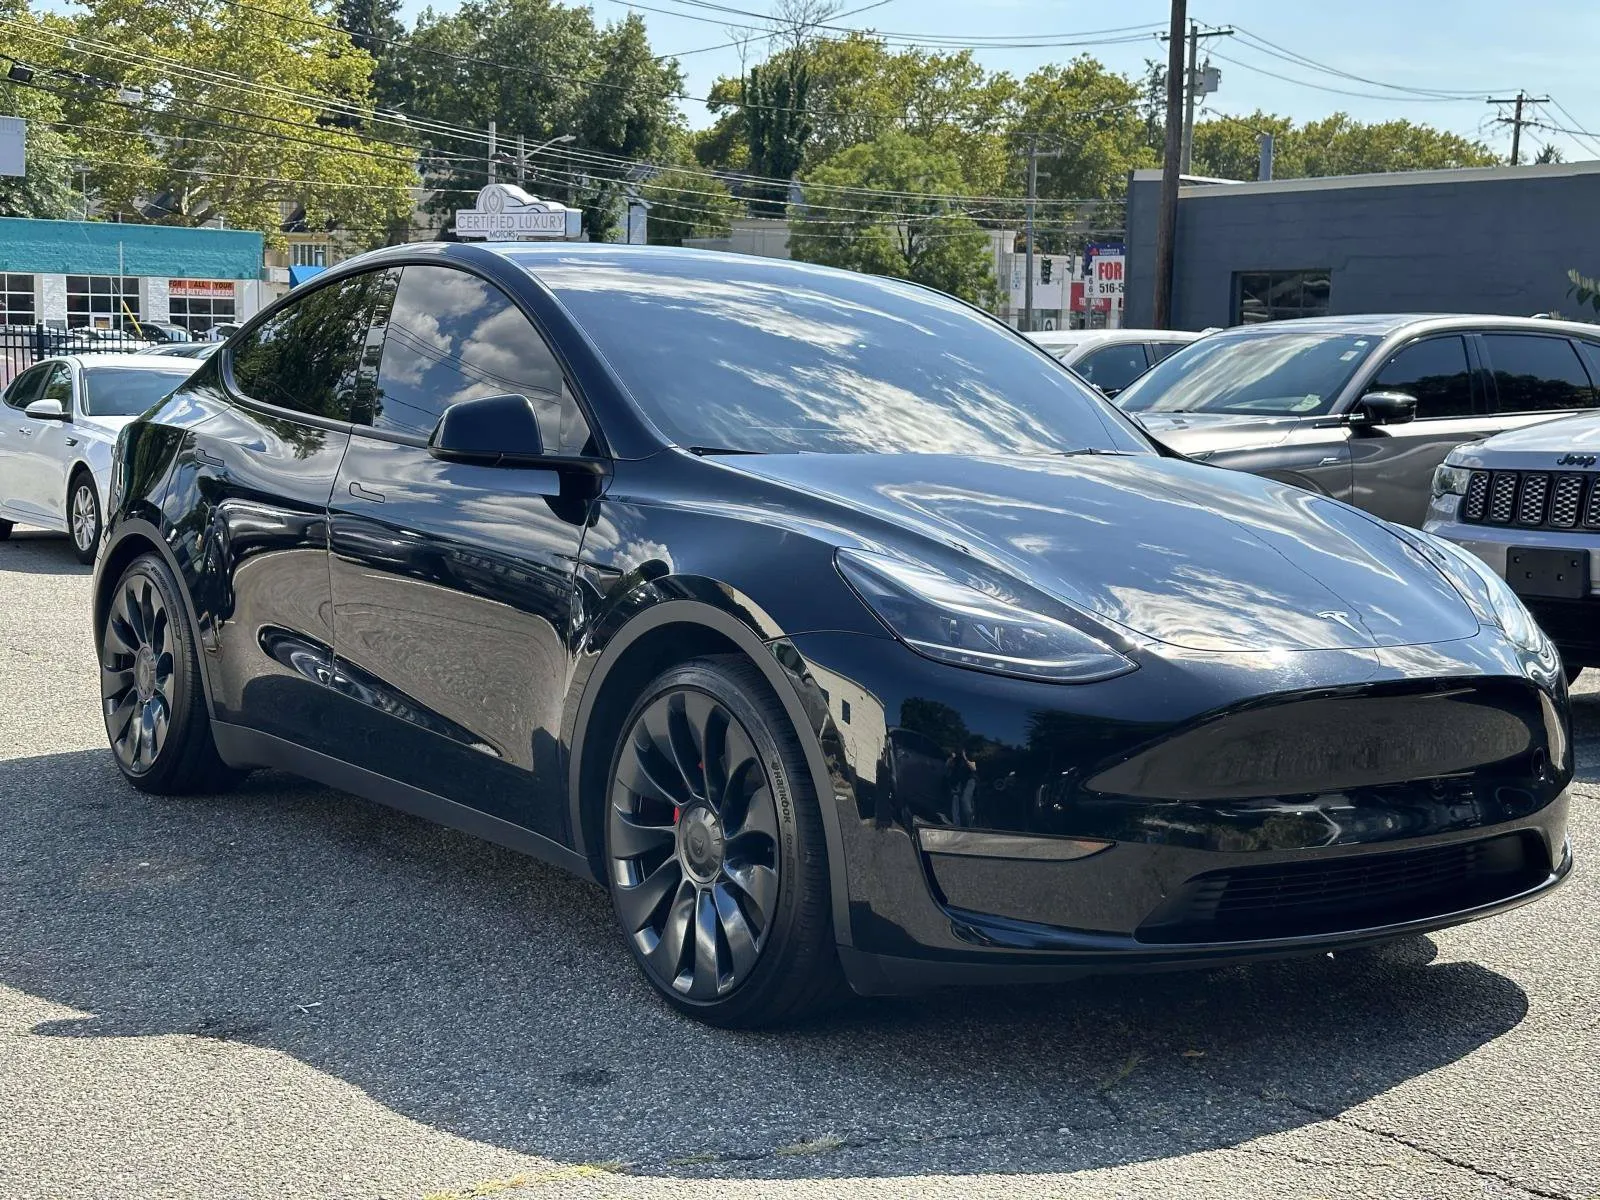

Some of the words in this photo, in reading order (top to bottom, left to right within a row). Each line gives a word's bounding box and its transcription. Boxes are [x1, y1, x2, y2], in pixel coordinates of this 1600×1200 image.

[457, 216, 514, 229] CERTIFIED
[519, 216, 564, 229] LUXURY
[490, 230, 516, 238] MOTORS
[1098, 262, 1122, 280] FOR
[1556, 453, 1597, 468] Jeep
